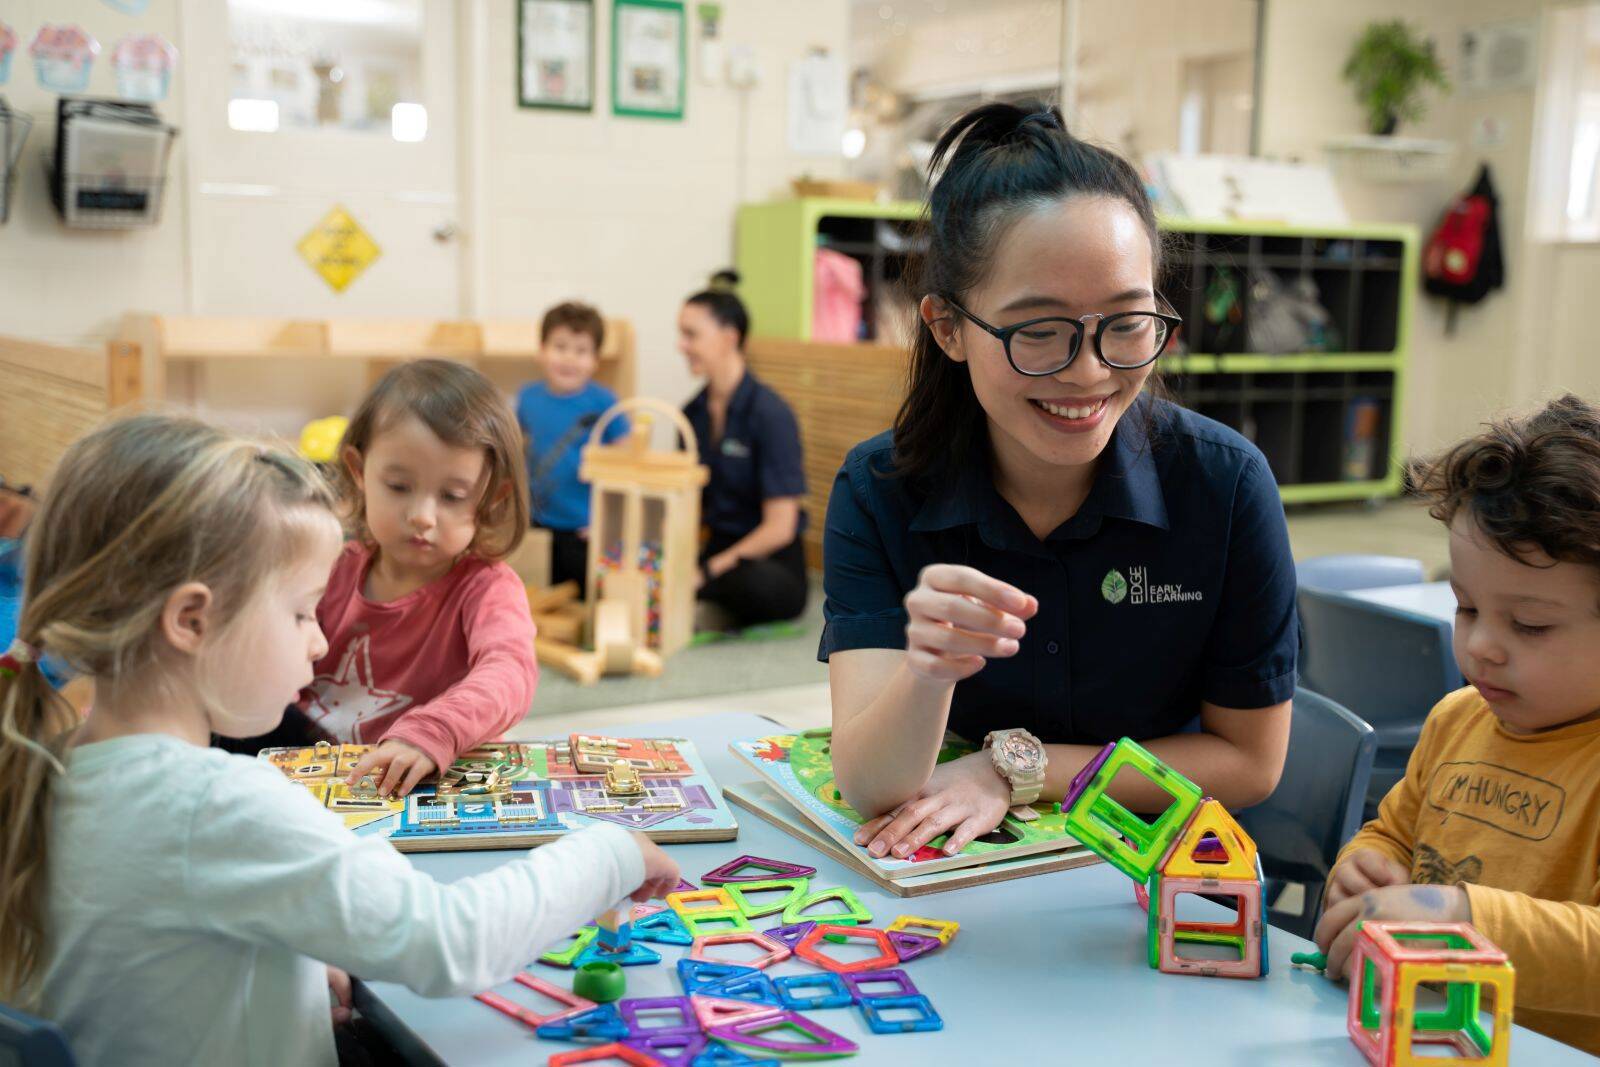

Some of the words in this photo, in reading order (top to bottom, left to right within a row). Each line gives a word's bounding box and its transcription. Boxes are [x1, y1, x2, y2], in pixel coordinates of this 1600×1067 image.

[1129, 565, 1143, 604] EDGE
[1150, 584, 1182, 595] EARLY
[1150, 591, 1203, 603] LEARNING
[1466, 776, 1551, 826] HUNGRY
